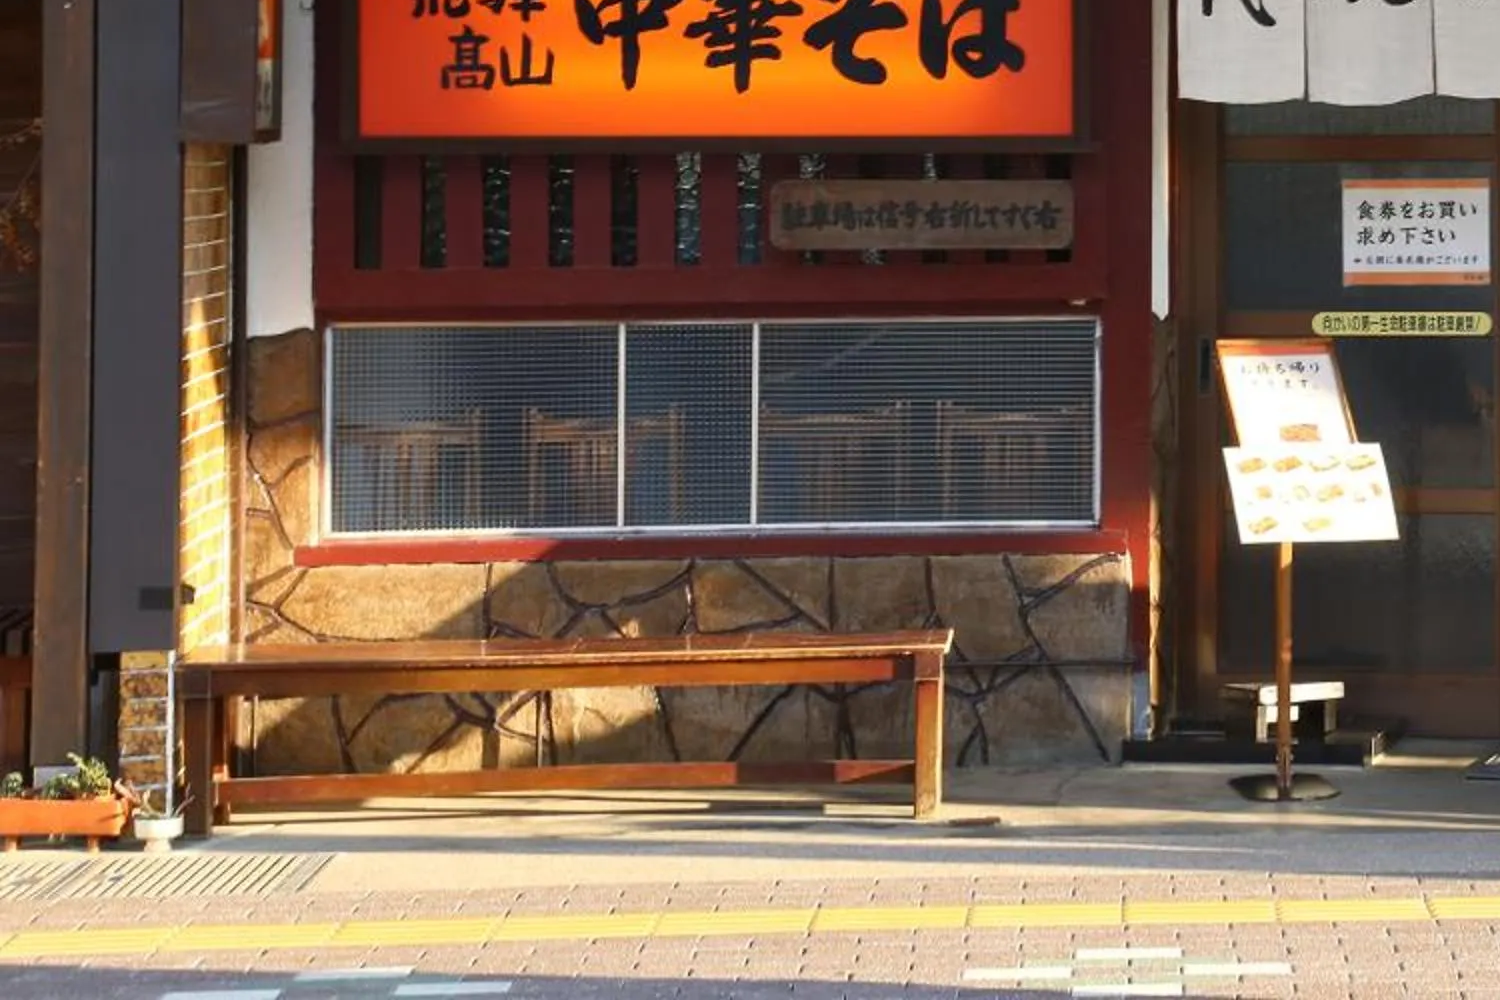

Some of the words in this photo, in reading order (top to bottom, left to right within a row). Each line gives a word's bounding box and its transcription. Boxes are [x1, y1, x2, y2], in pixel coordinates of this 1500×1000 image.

[1356, 199, 1478, 221] 食券をお買い
[1356, 226, 1457, 246] 求め下さい
